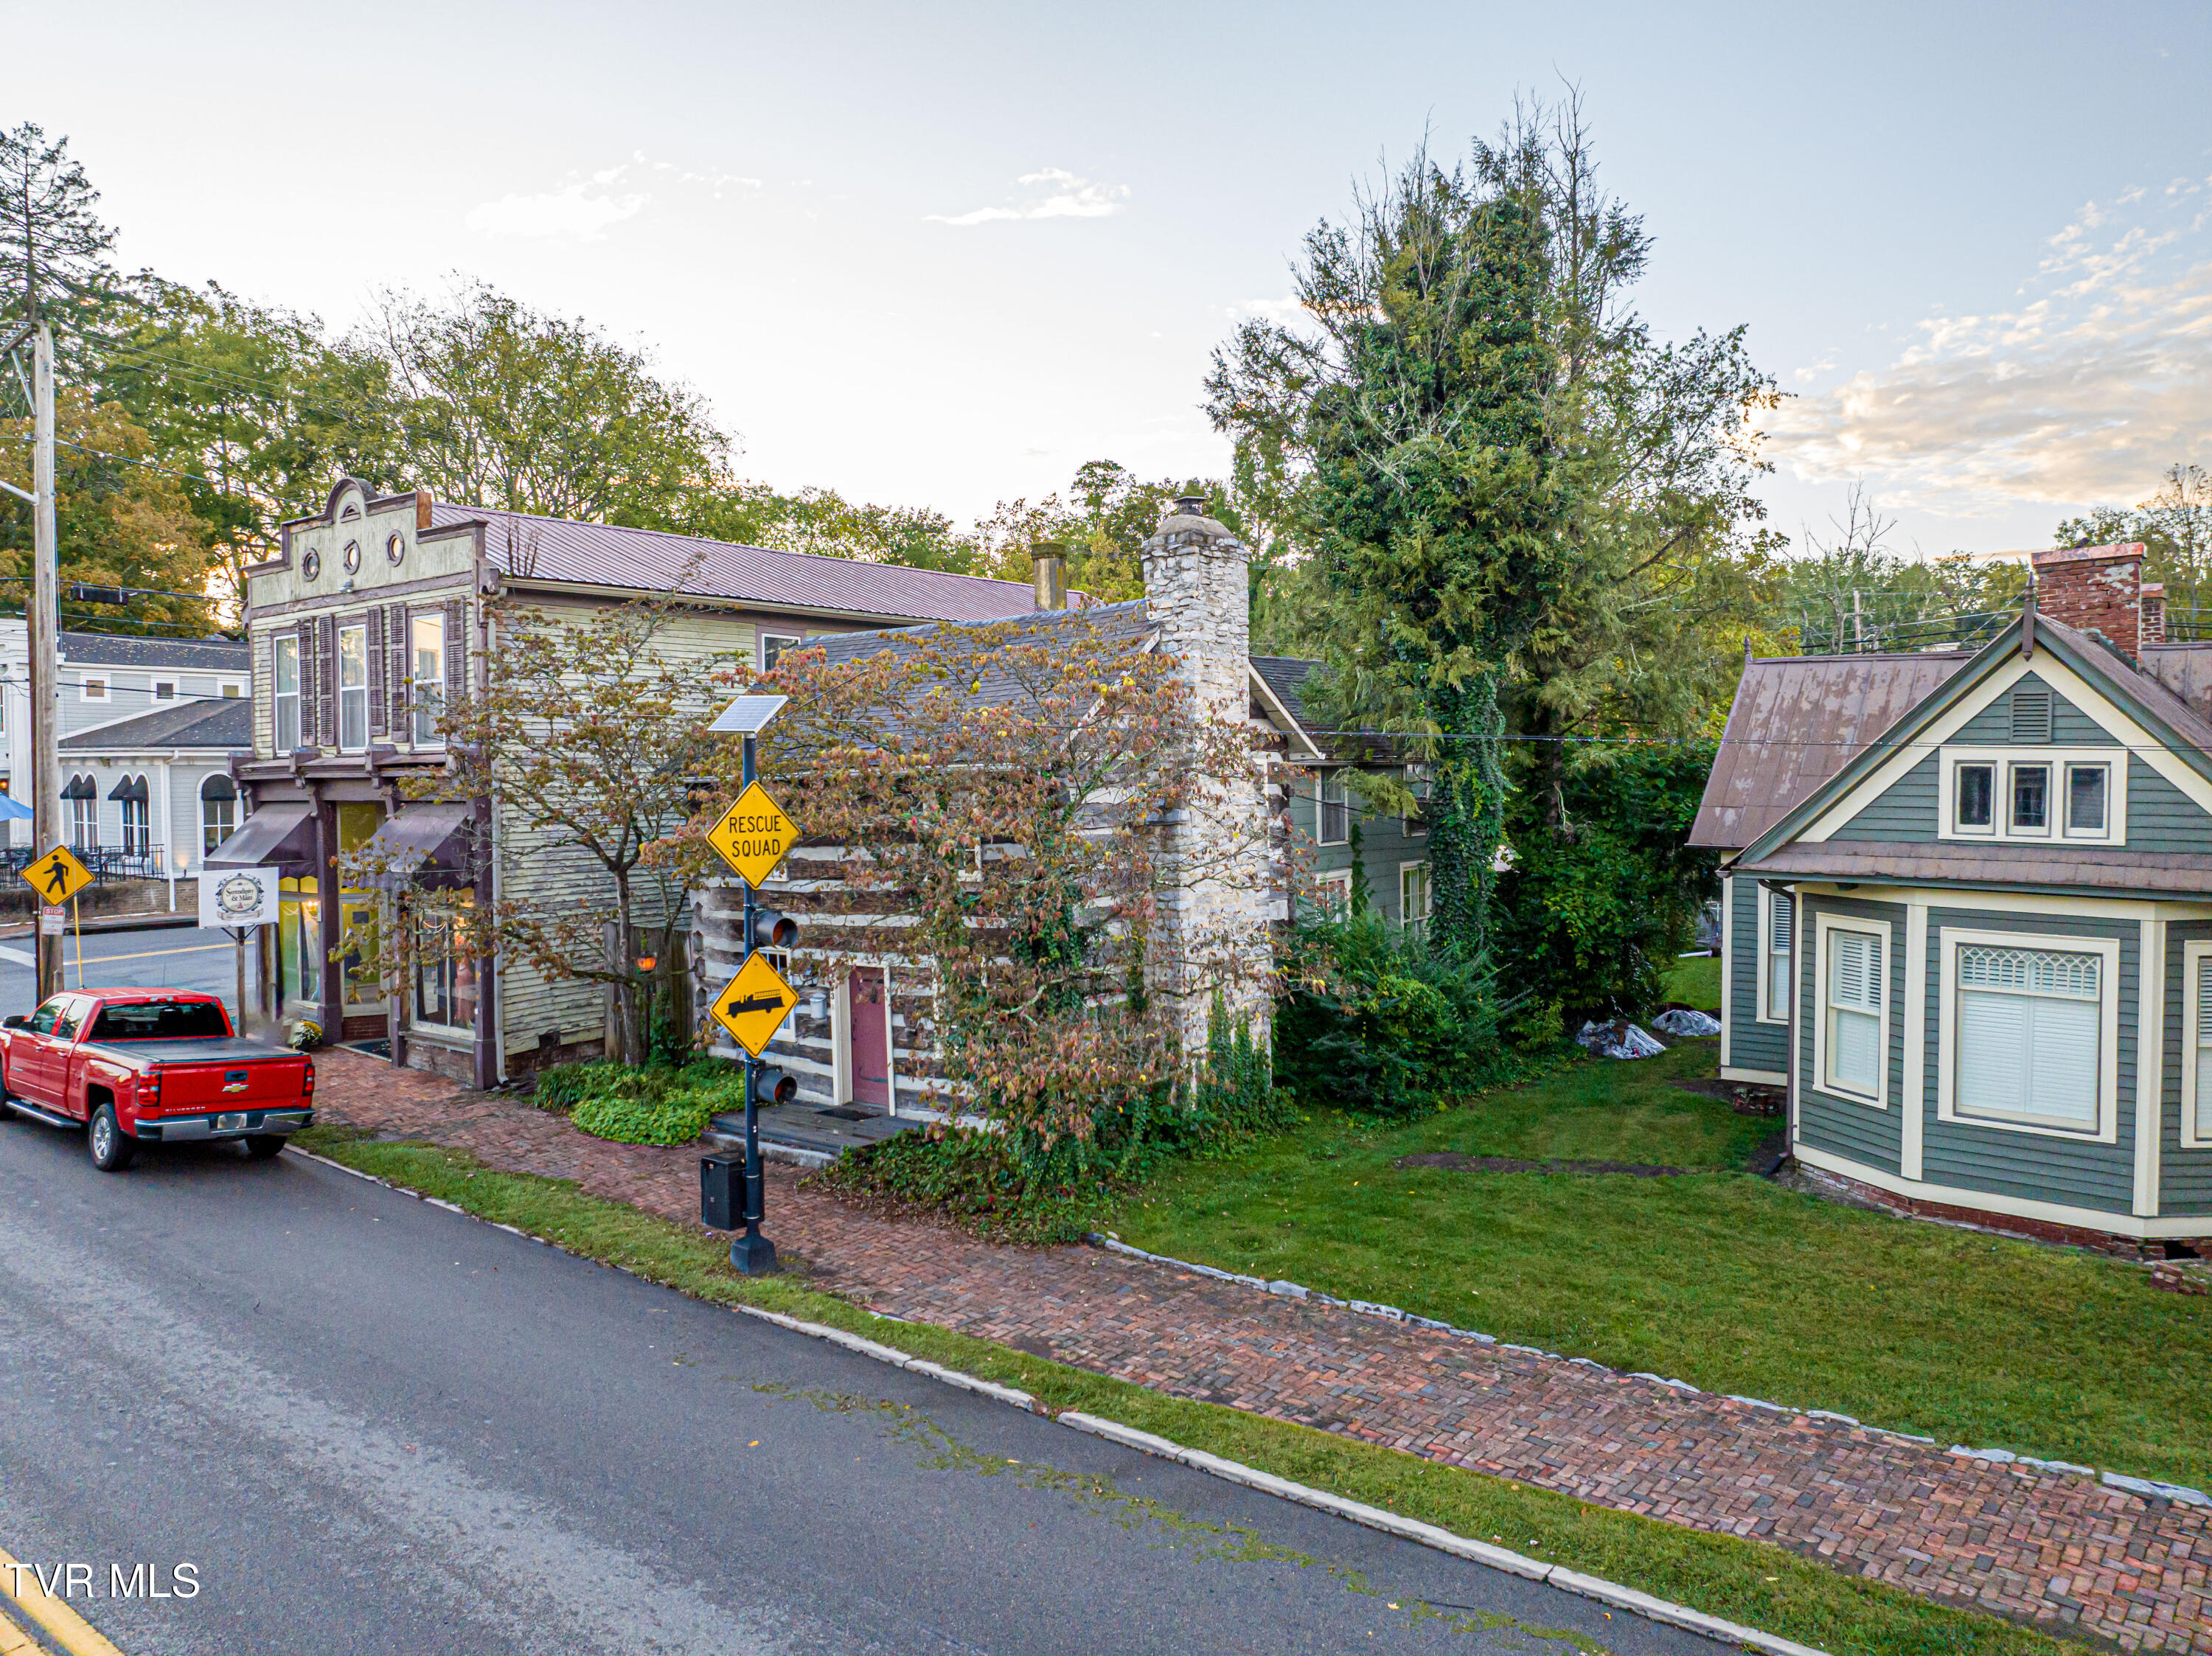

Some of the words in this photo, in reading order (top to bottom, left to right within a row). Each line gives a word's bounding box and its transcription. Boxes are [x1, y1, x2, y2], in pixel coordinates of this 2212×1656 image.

[729, 815, 782, 833] RESCUE
[732, 839, 780, 857] SQUAD
[226, 888, 254, 897] Serendipity
